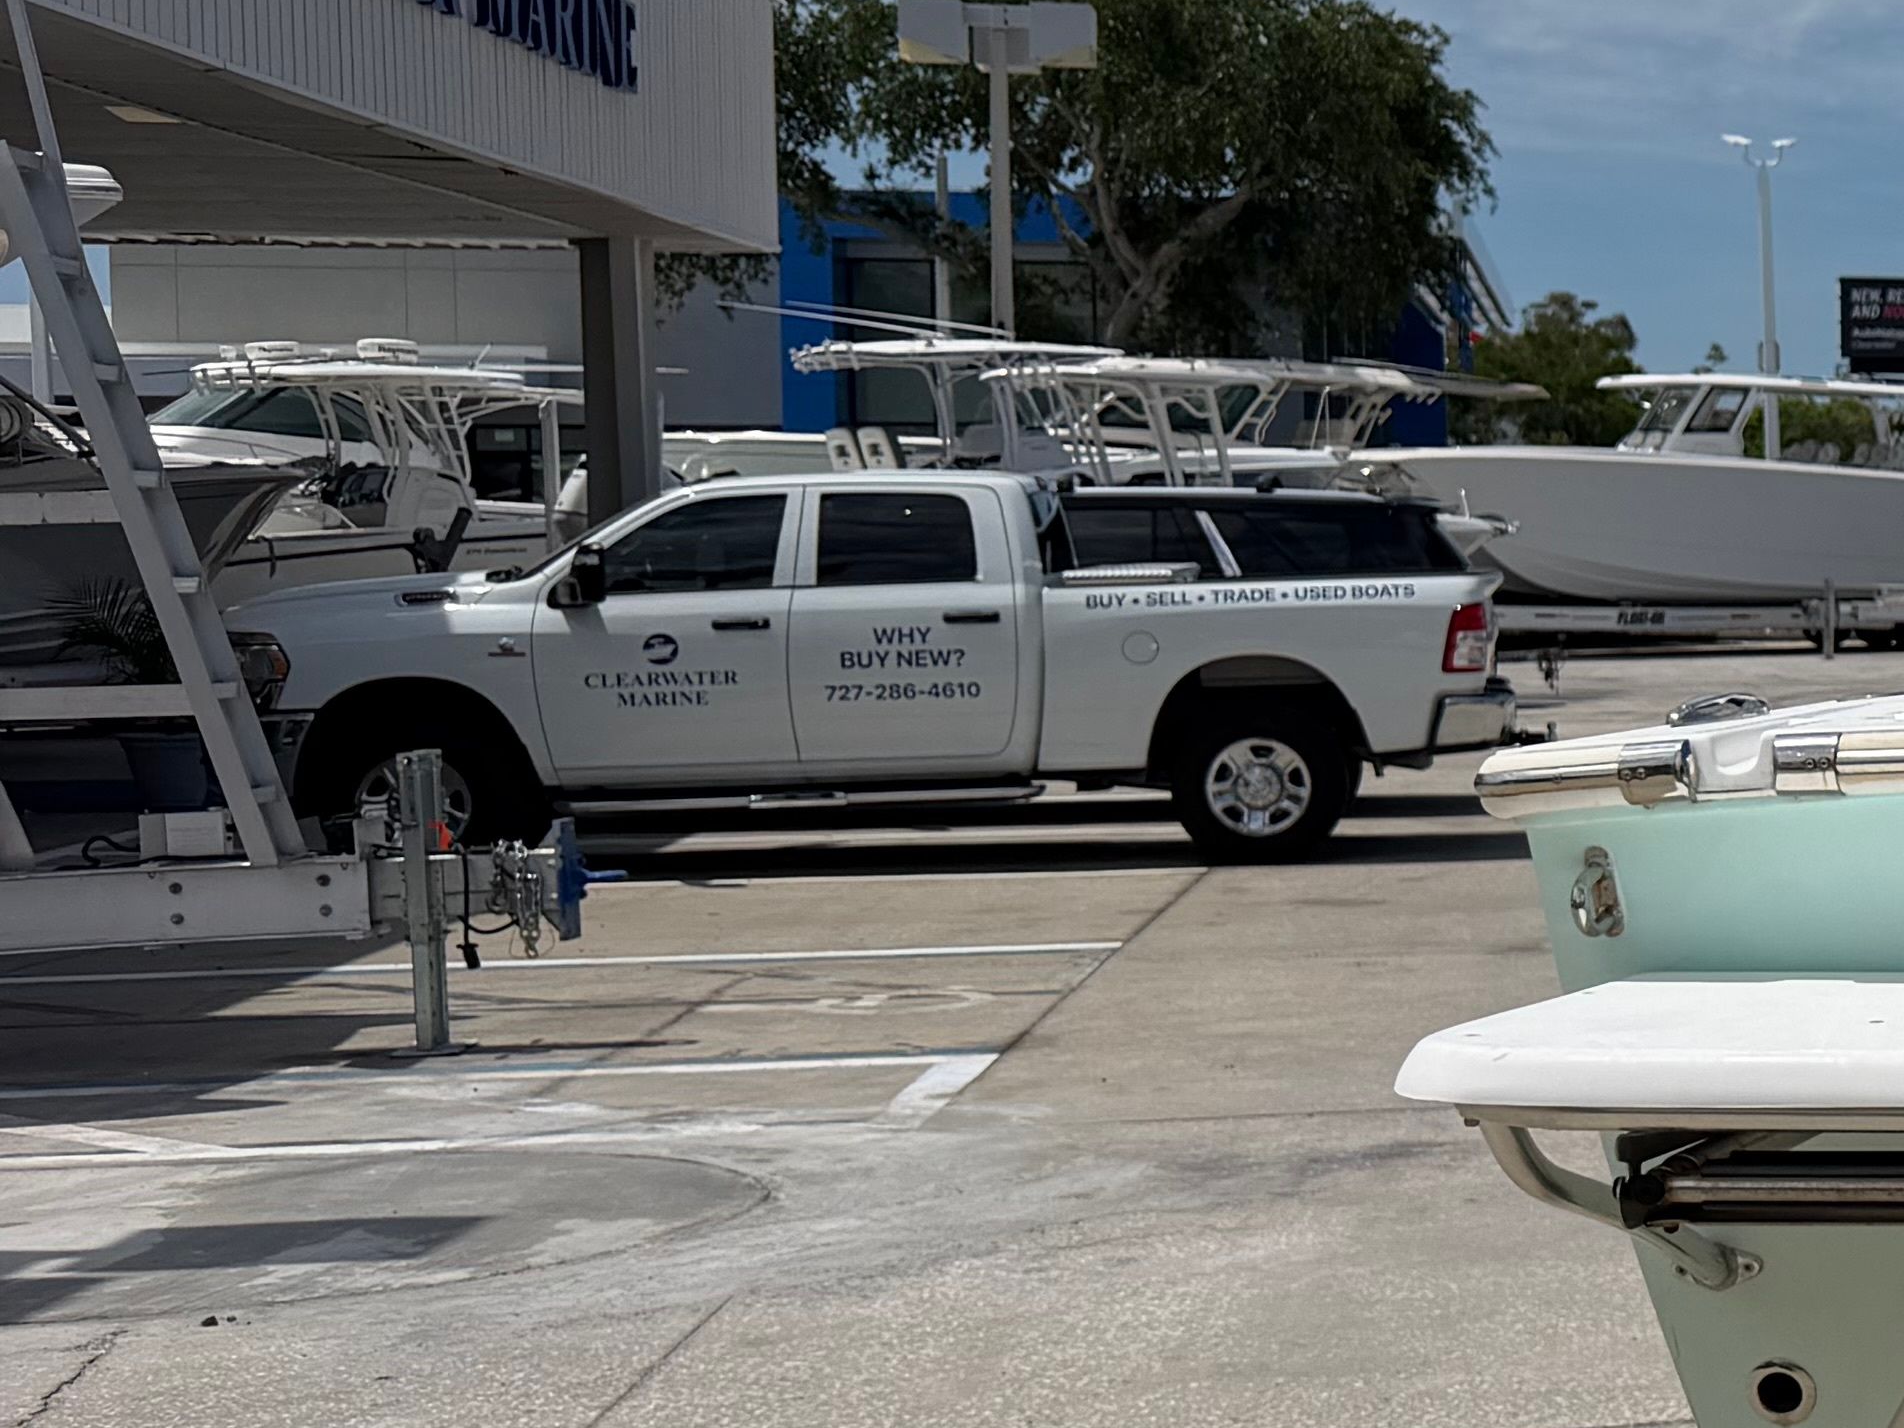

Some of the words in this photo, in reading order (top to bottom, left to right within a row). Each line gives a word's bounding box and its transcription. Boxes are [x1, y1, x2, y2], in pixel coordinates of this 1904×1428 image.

[1852, 304, 1881, 320] AND
[1086, 594, 1126, 610] BUY
[1145, 591, 1192, 608] SELL
[1210, 588, 1277, 604] TRADE
[1294, 585, 1347, 601] USED
[1352, 583, 1416, 600] BOATS
[873, 626, 931, 646] WHY
[840, 650, 890, 670] BUY
[897, 648, 966, 668] NEW?
[584, 670, 738, 690] CLEARWATER
[616, 690, 710, 708] MARINE
[825, 682, 982, 702] 727-286-4610
